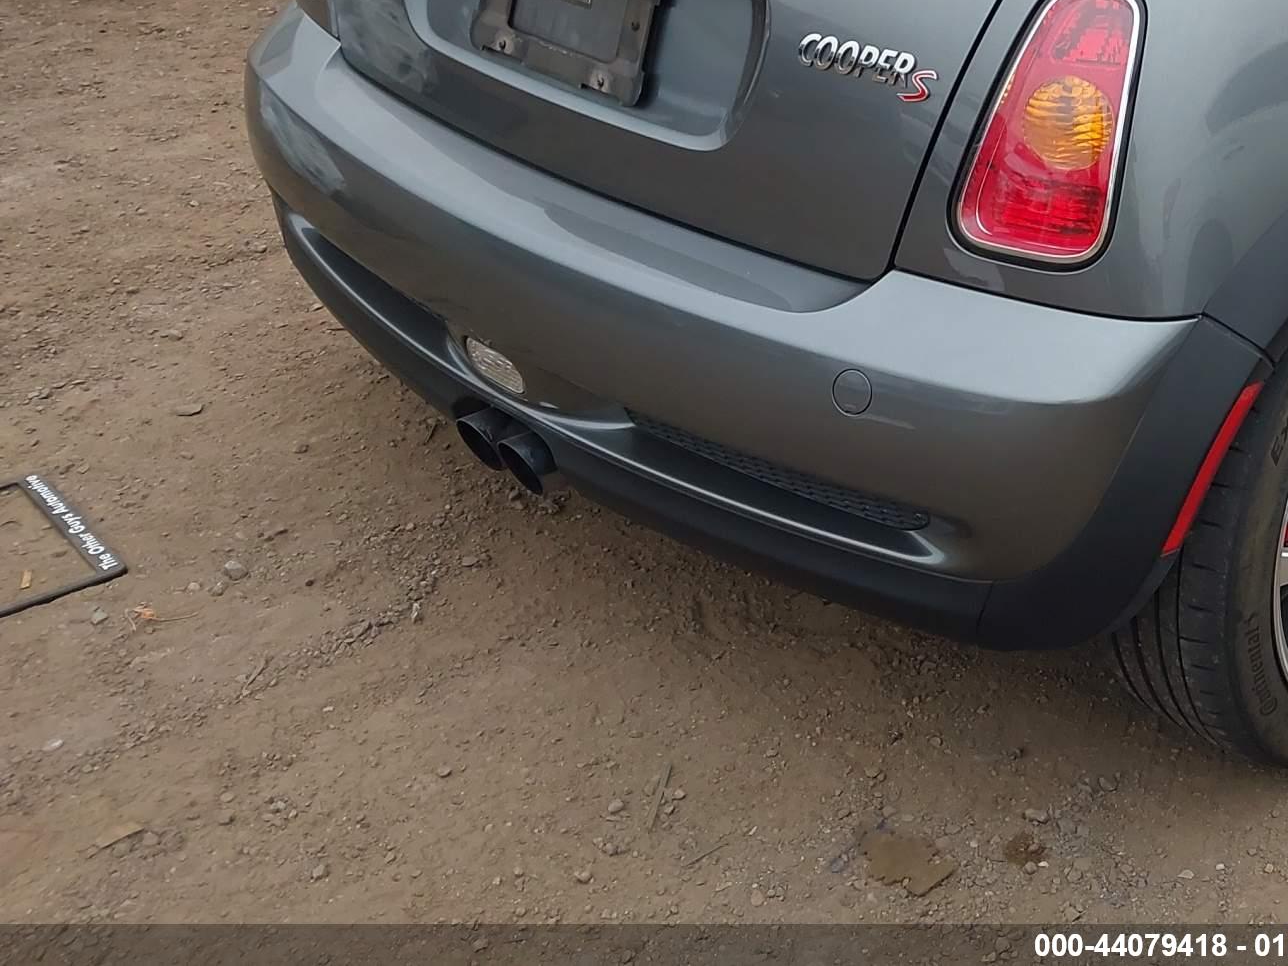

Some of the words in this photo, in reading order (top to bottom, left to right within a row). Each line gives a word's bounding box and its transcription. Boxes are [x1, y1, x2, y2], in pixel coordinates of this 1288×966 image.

[798, 32, 917, 90] COOPER
[896, 69, 939, 103] S
[25, 474, 70, 515] Automotive
[61, 513, 86, 534] Guys
[78, 532, 105, 555] Other
[98, 552, 119, 572] The
